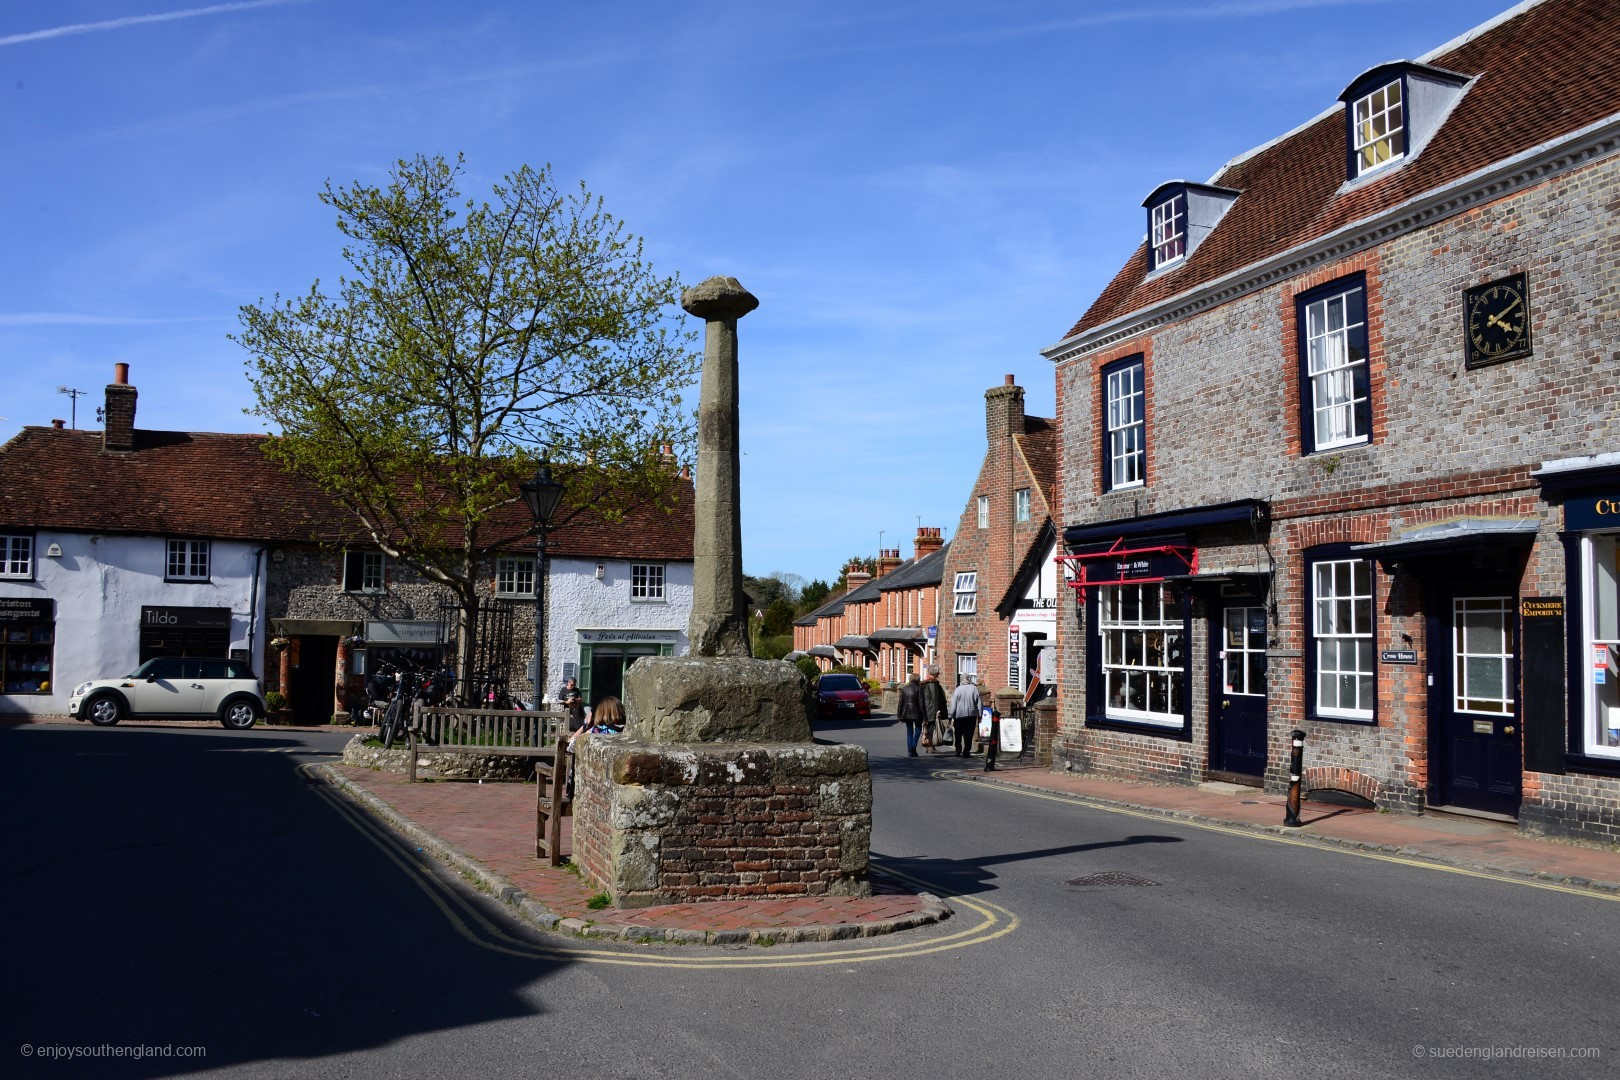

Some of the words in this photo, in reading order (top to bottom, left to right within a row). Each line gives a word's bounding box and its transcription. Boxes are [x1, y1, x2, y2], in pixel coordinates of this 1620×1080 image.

[1032, 598, 1045, 608] THE
[1523, 608, 1562, 617] EMPORIUM
[145, 610, 178, 625] Tilda
[625, 632, 656, 641] Alfriston
[1397, 652, 1413, 660] House
